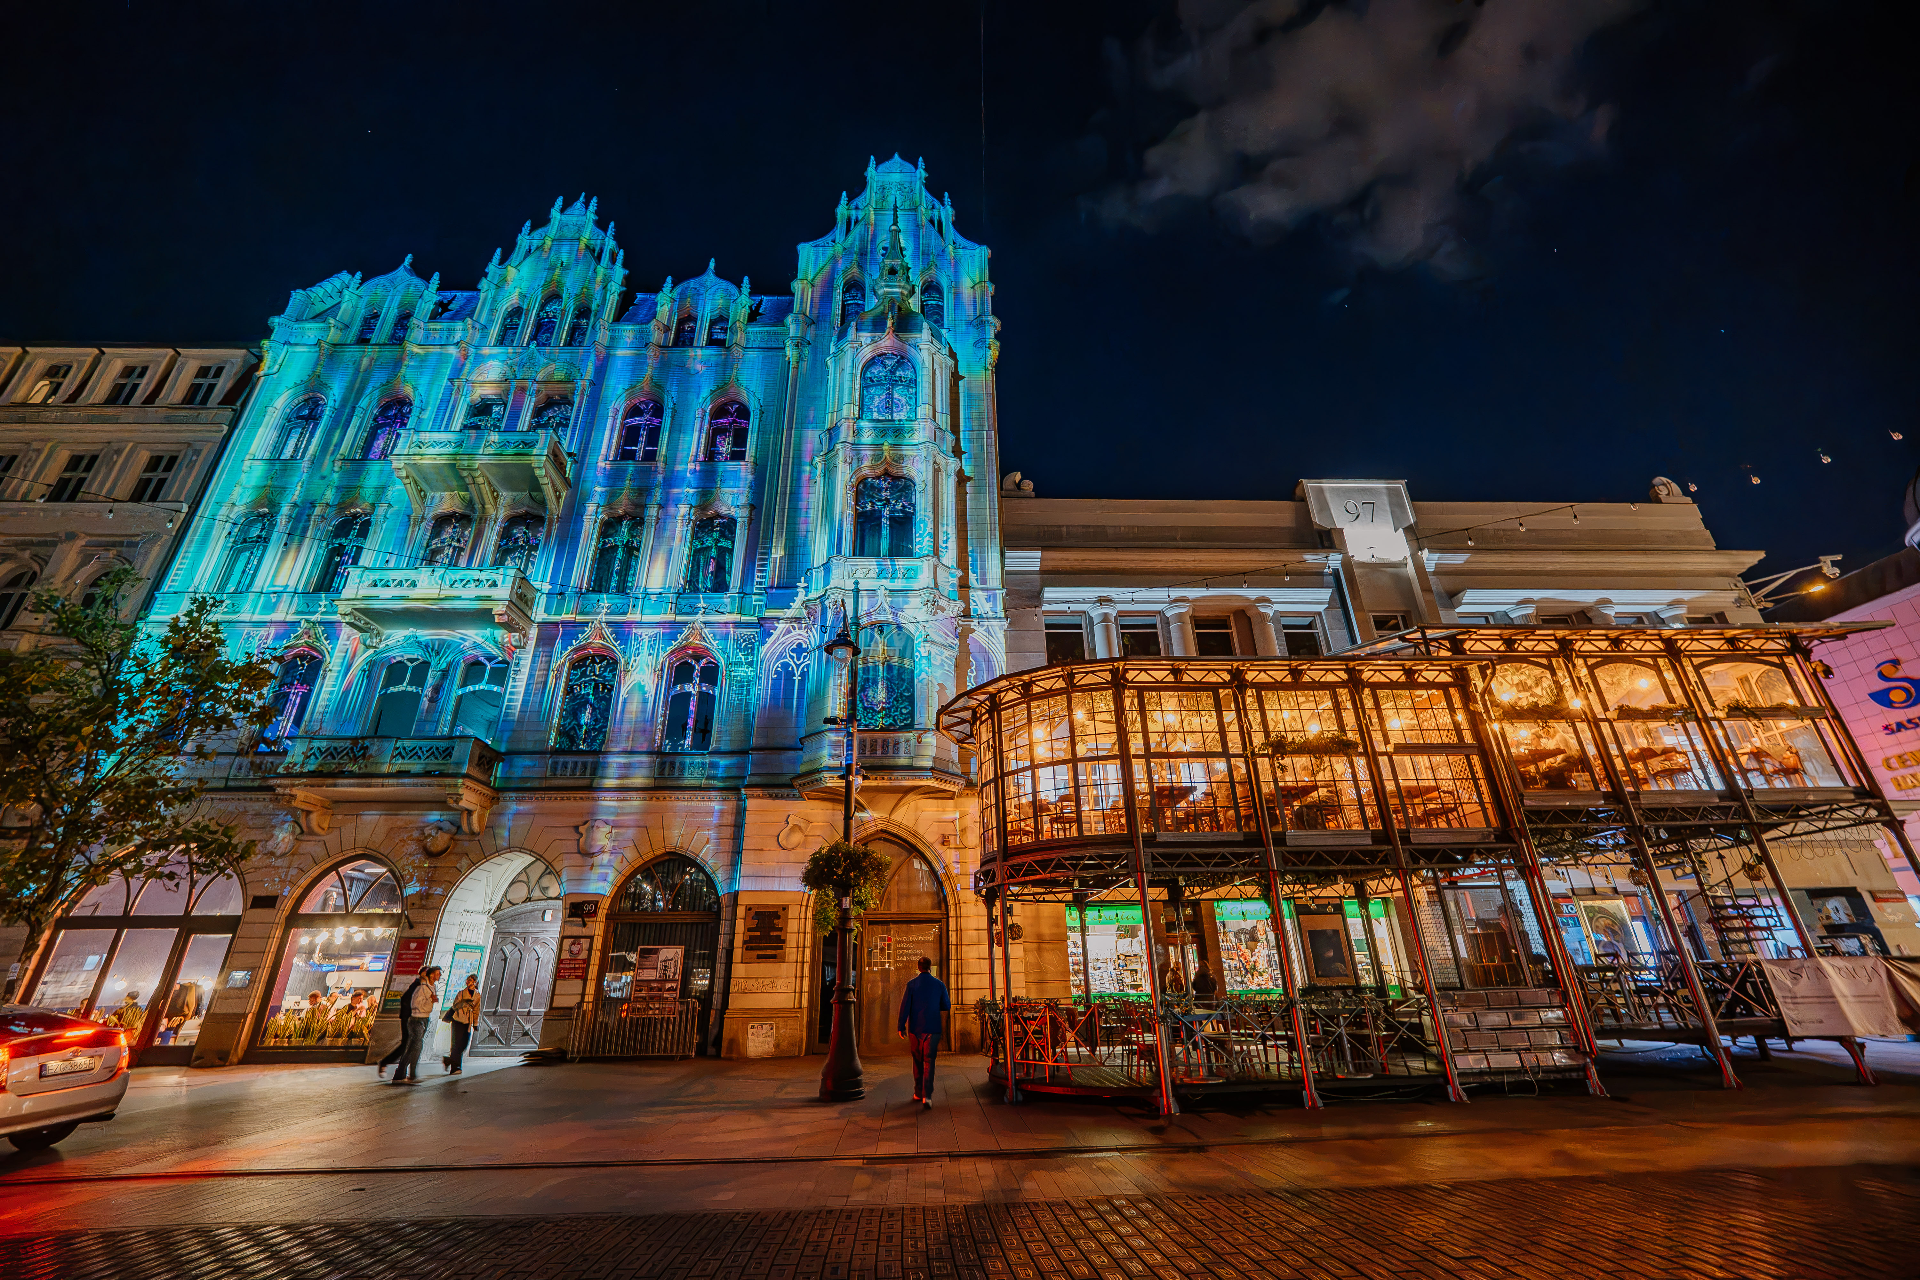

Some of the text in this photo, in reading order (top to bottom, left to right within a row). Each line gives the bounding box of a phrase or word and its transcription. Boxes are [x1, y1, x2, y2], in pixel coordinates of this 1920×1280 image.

[1343, 499, 1376, 523] 97
[1882, 716, 1920, 735] SAS
[583, 903, 595, 914] 99
